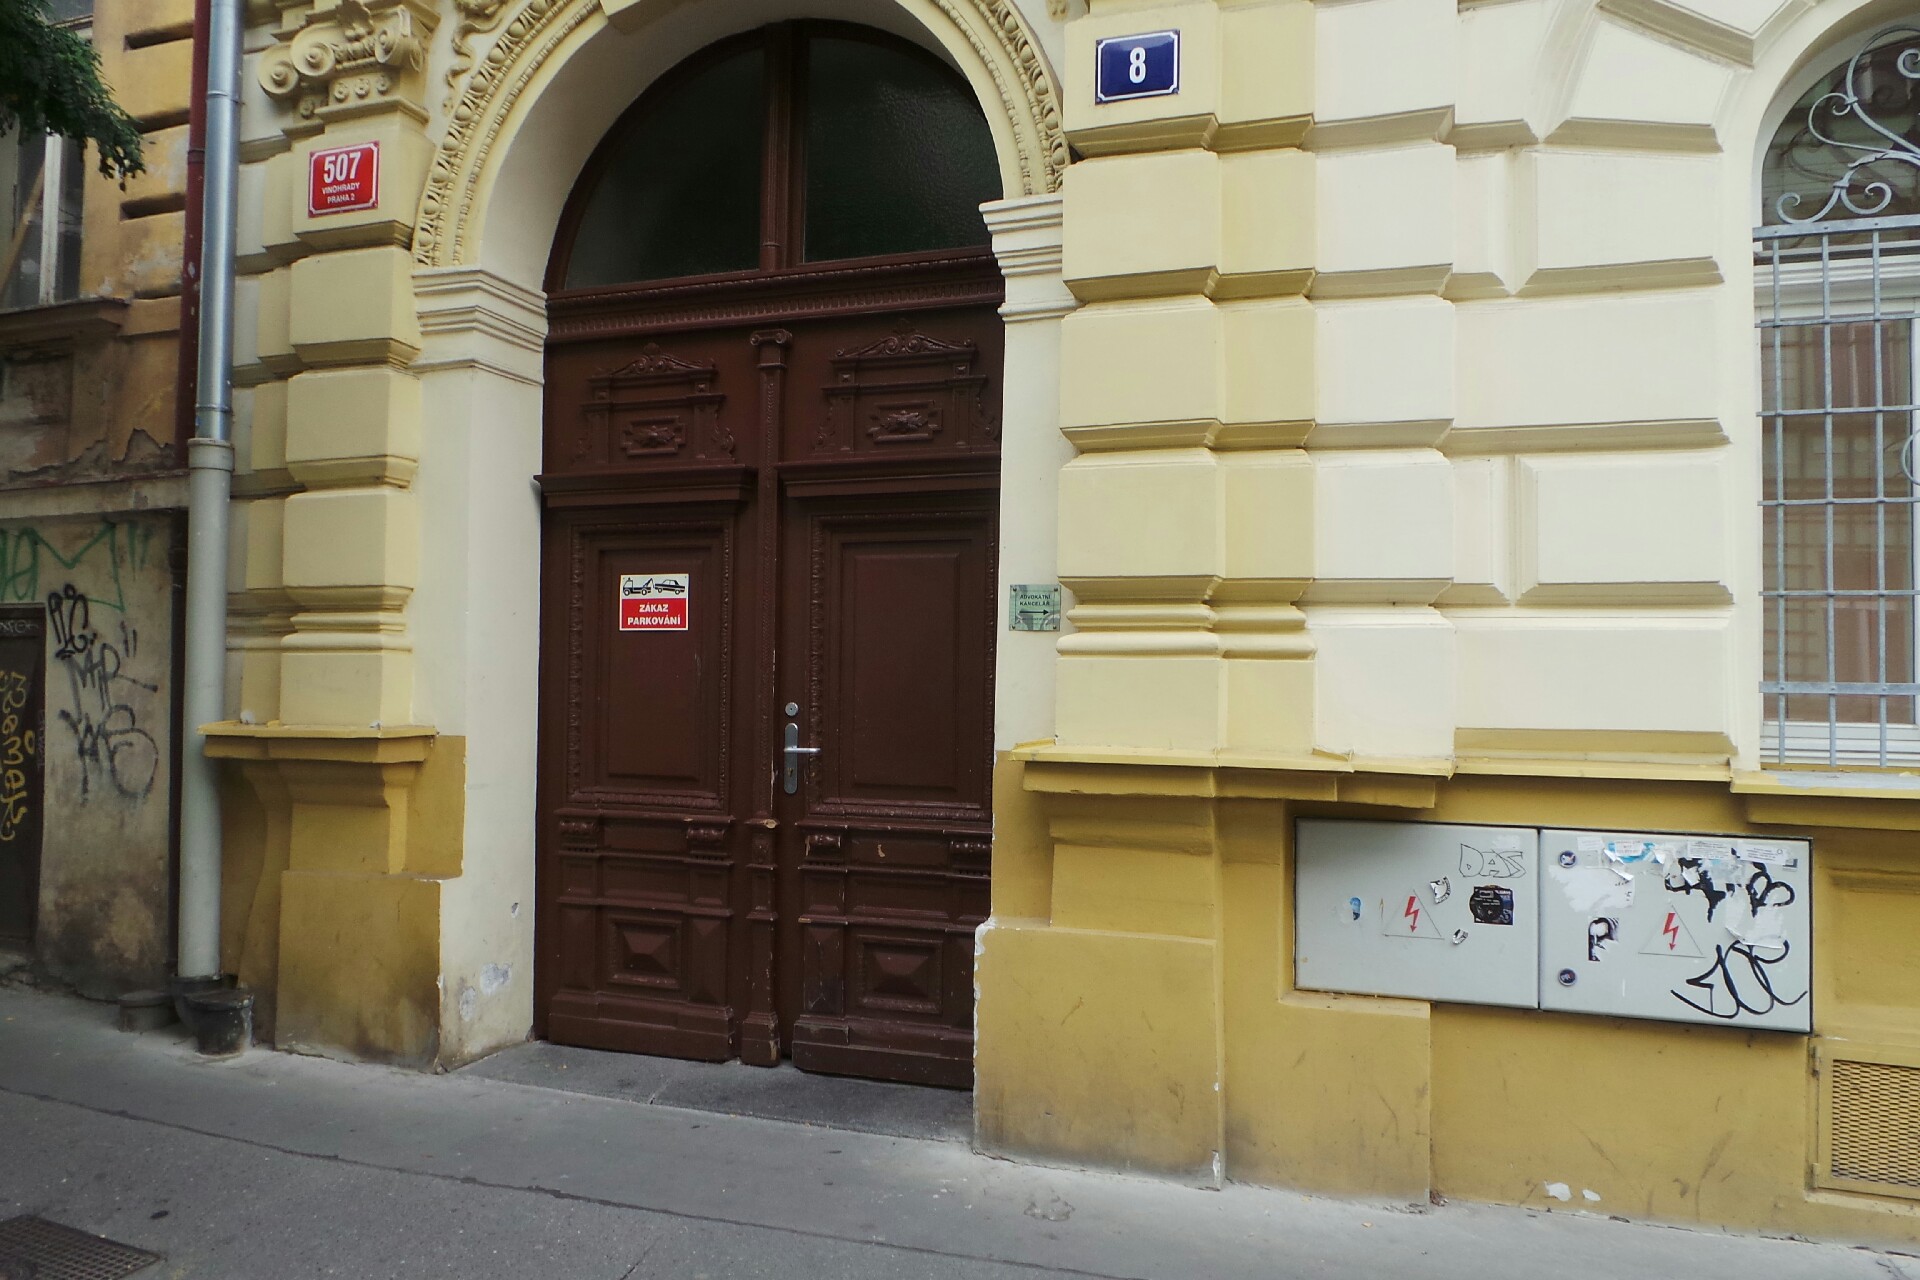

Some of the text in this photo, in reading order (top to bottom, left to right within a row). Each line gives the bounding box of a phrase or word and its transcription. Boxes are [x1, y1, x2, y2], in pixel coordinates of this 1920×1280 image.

[1129, 47, 1146, 83] 8
[323, 151, 361, 183] 507
[322, 182, 360, 195] VINOHRADY
[327, 193, 355, 204] PRAHA 2
[639, 602, 669, 613] ZÁKAZ
[627, 614, 681, 626] PARKOVÁNÍ
